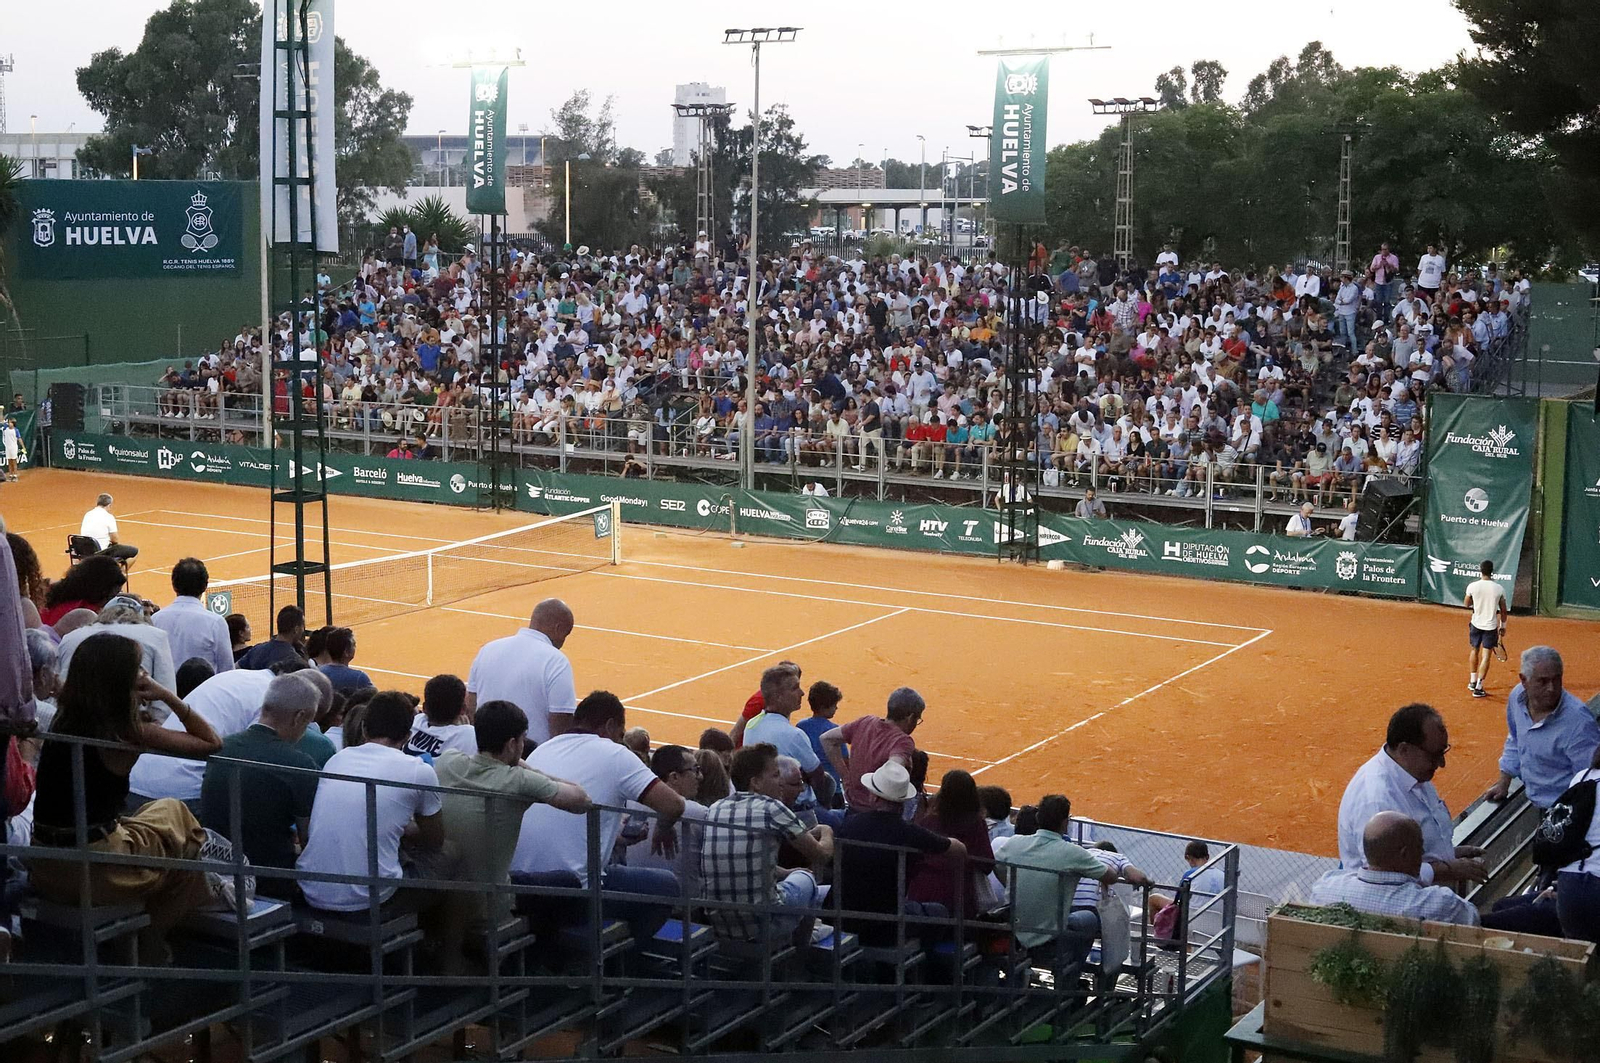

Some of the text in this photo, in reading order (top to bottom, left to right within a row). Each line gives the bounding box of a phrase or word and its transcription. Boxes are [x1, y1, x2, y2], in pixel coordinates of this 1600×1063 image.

[474, 110, 485, 189] HUELVA
[486, 109, 495, 187] Ayuntamiento de
[1001, 104, 1020, 195] HUELVA
[1021, 103, 1034, 192] Ayuntamiento de
[64, 210, 154, 223] Ayuntamiento de
[65, 226, 158, 245] HUELVA
[1444, 432, 1495, 448] Fundación
[1472, 444, 1520, 455] CAJA RURAL
[353, 466, 387, 479] Barceló
[397, 472, 423, 483] Huelva
[545, 487, 571, 495] Fundación
[660, 498, 686, 511] SER
[740, 507, 770, 519] HUELVA
[919, 519, 949, 532] HTV
[1441, 514, 1509, 528] Puerto de Huelva
[1082, 534, 1126, 549] Fundación
[1183, 542, 1230, 554] DIPUTACIÓN
[1107, 546, 1148, 557] CAJA RURAL
[1196, 551, 1229, 561] HUELVA
[1363, 564, 1396, 574] Palos de
[1454, 560, 1481, 571] Fundaci
[1362, 573, 1406, 585] la Frontera
[410, 730, 445, 757] NIKE
